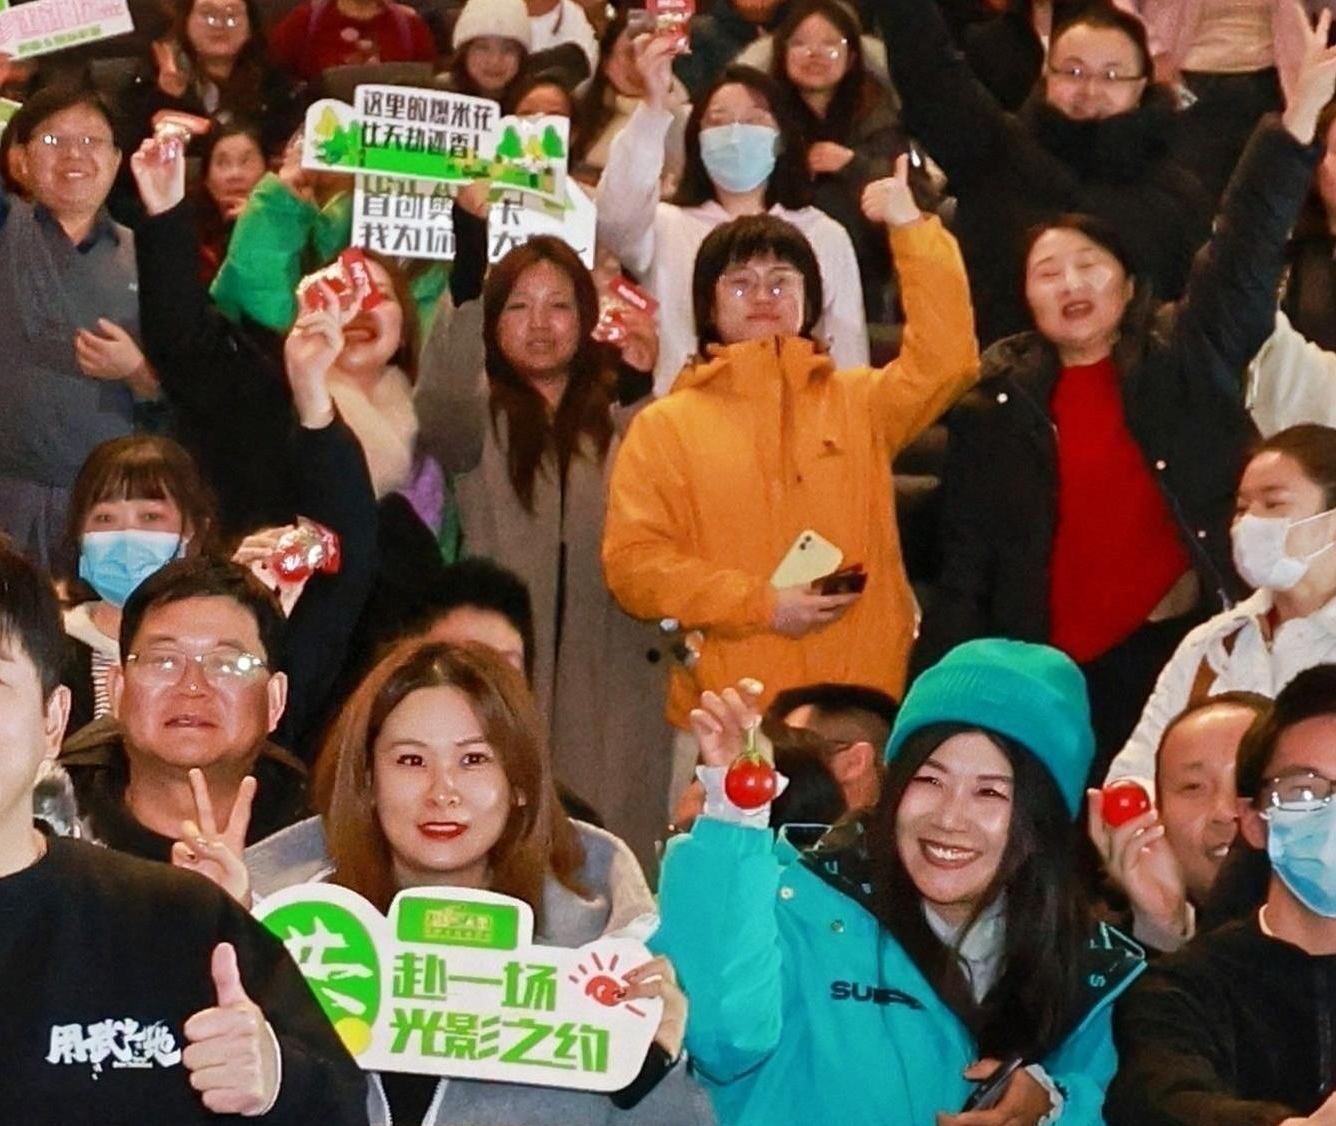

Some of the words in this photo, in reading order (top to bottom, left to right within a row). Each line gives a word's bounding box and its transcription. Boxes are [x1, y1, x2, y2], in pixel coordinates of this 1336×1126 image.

[362, 90, 493, 133] 这里的爆米花
[392, 951, 559, 1013] 赴一场
[44, 1018, 182, 1070] 用武之地
[389, 1007, 611, 1074] 光影之约
